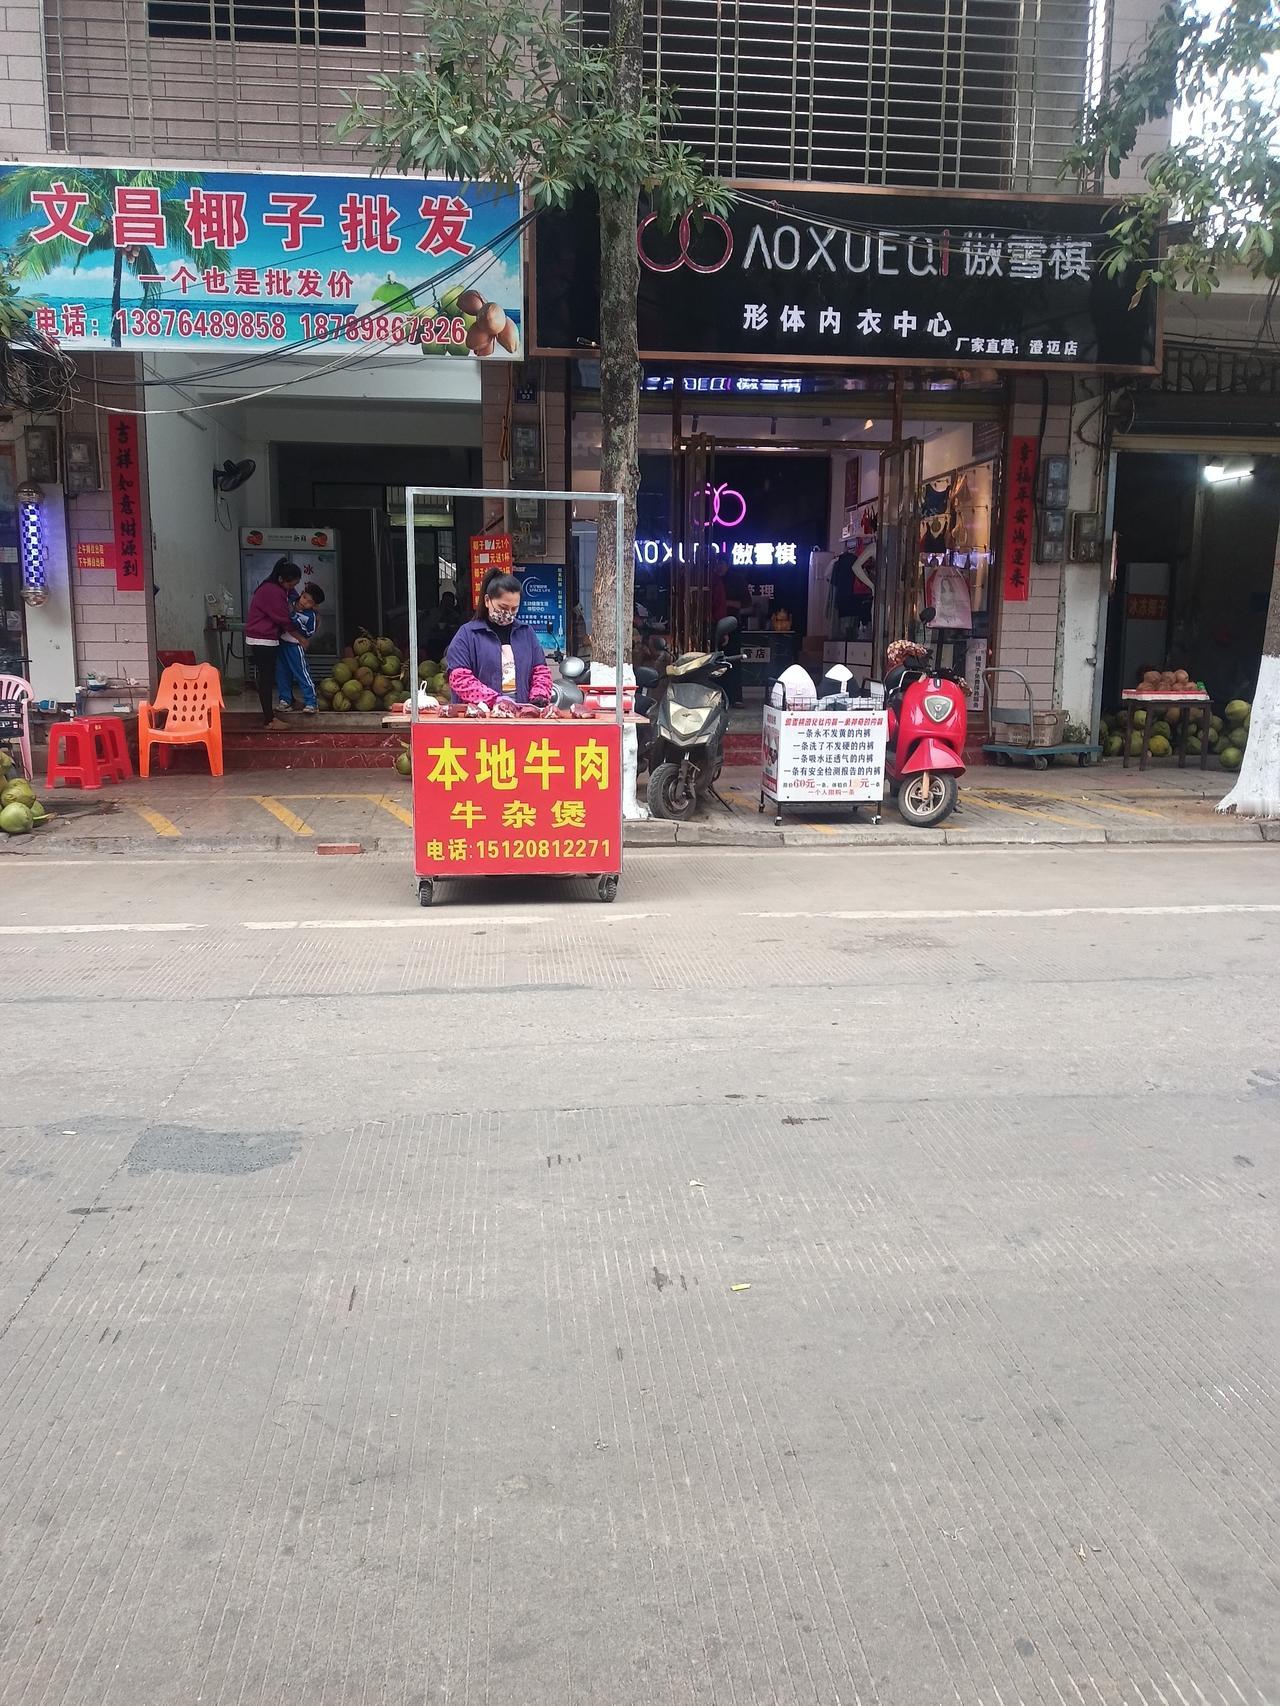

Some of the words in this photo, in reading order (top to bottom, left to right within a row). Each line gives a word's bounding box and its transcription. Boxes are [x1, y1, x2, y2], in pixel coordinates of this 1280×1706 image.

[30, 183, 477, 257] 文昌椰子批发
[741, 225, 950, 278] AOXUEQI
[137, 266, 355, 299] 一个也是批发价
[300, 312, 466, 346] 18789867326
[743, 303, 952, 338] 形体内衣中心
[115, 420, 138, 578] 吉祥如意财源到
[1010, 441, 1030, 588] 幸福平安鸿运来
[731, 542, 797, 565] 傲雪棋
[793, 741, 875, 751] 一条洗了不发硬的内裤
[798, 728, 872, 738] 一条永不发黄的内裤
[426, 737, 610, 791] 本地牛肉
[784, 766, 881, 776] 一条有安全检测报告的内裤
[792, 754, 874, 764] 一条吸水还透气的内裤
[450, 800, 586, 829] 牛杂煲
